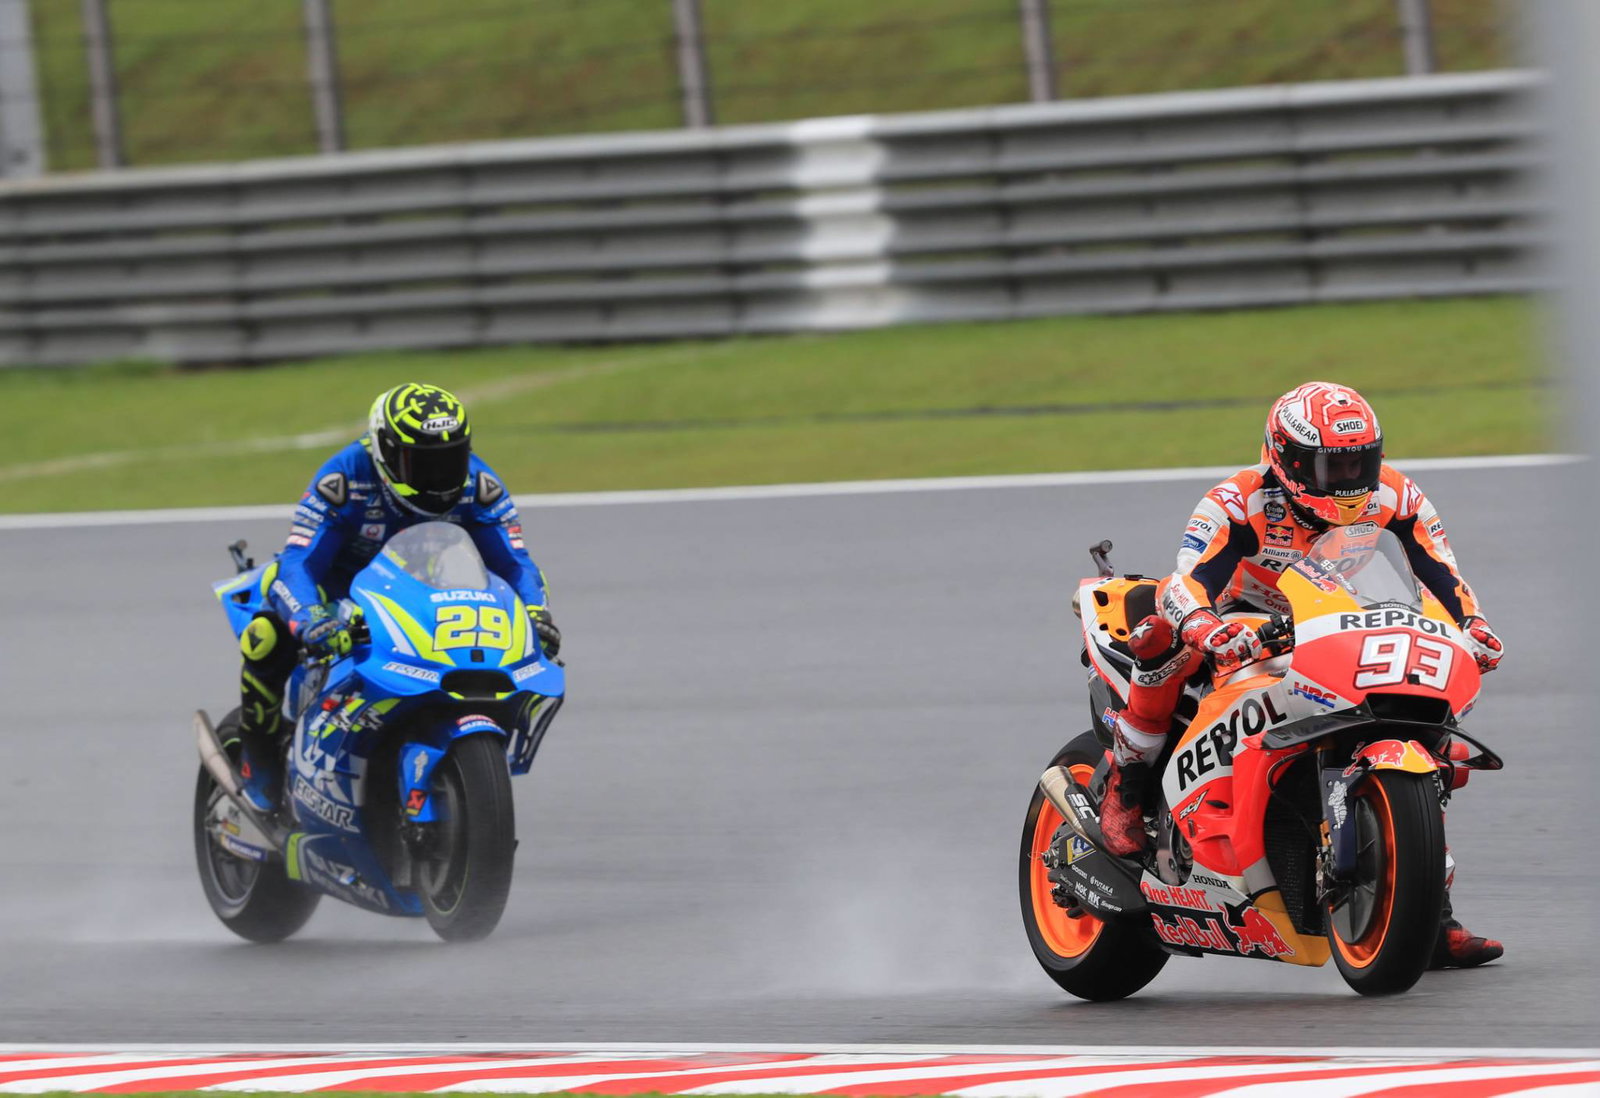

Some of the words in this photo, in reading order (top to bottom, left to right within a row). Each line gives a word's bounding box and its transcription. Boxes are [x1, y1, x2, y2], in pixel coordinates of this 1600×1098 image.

[426, 419, 455, 430] HJC
[1282, 406, 1318, 443] PULL&BEAR
[1336, 421, 1364, 432] SHOEI
[1335, 487, 1369, 497] PULL&BEAR
[1262, 548, 1290, 558] Allianz
[1320, 559, 1335, 571] 93
[272, 580, 302, 613] SUZUKI
[430, 590, 497, 603] SUZUKI
[432, 605, 513, 652] 29
[1340, 610, 1453, 639] REPSOL
[1353, 631, 1455, 692] 93
[1293, 681, 1337, 709] HRC
[1176, 690, 1287, 792] REPSOL
[1074, 881, 1087, 896] NGK
[1193, 874, 1231, 890] HONDA
[1140, 881, 1171, 905] One
